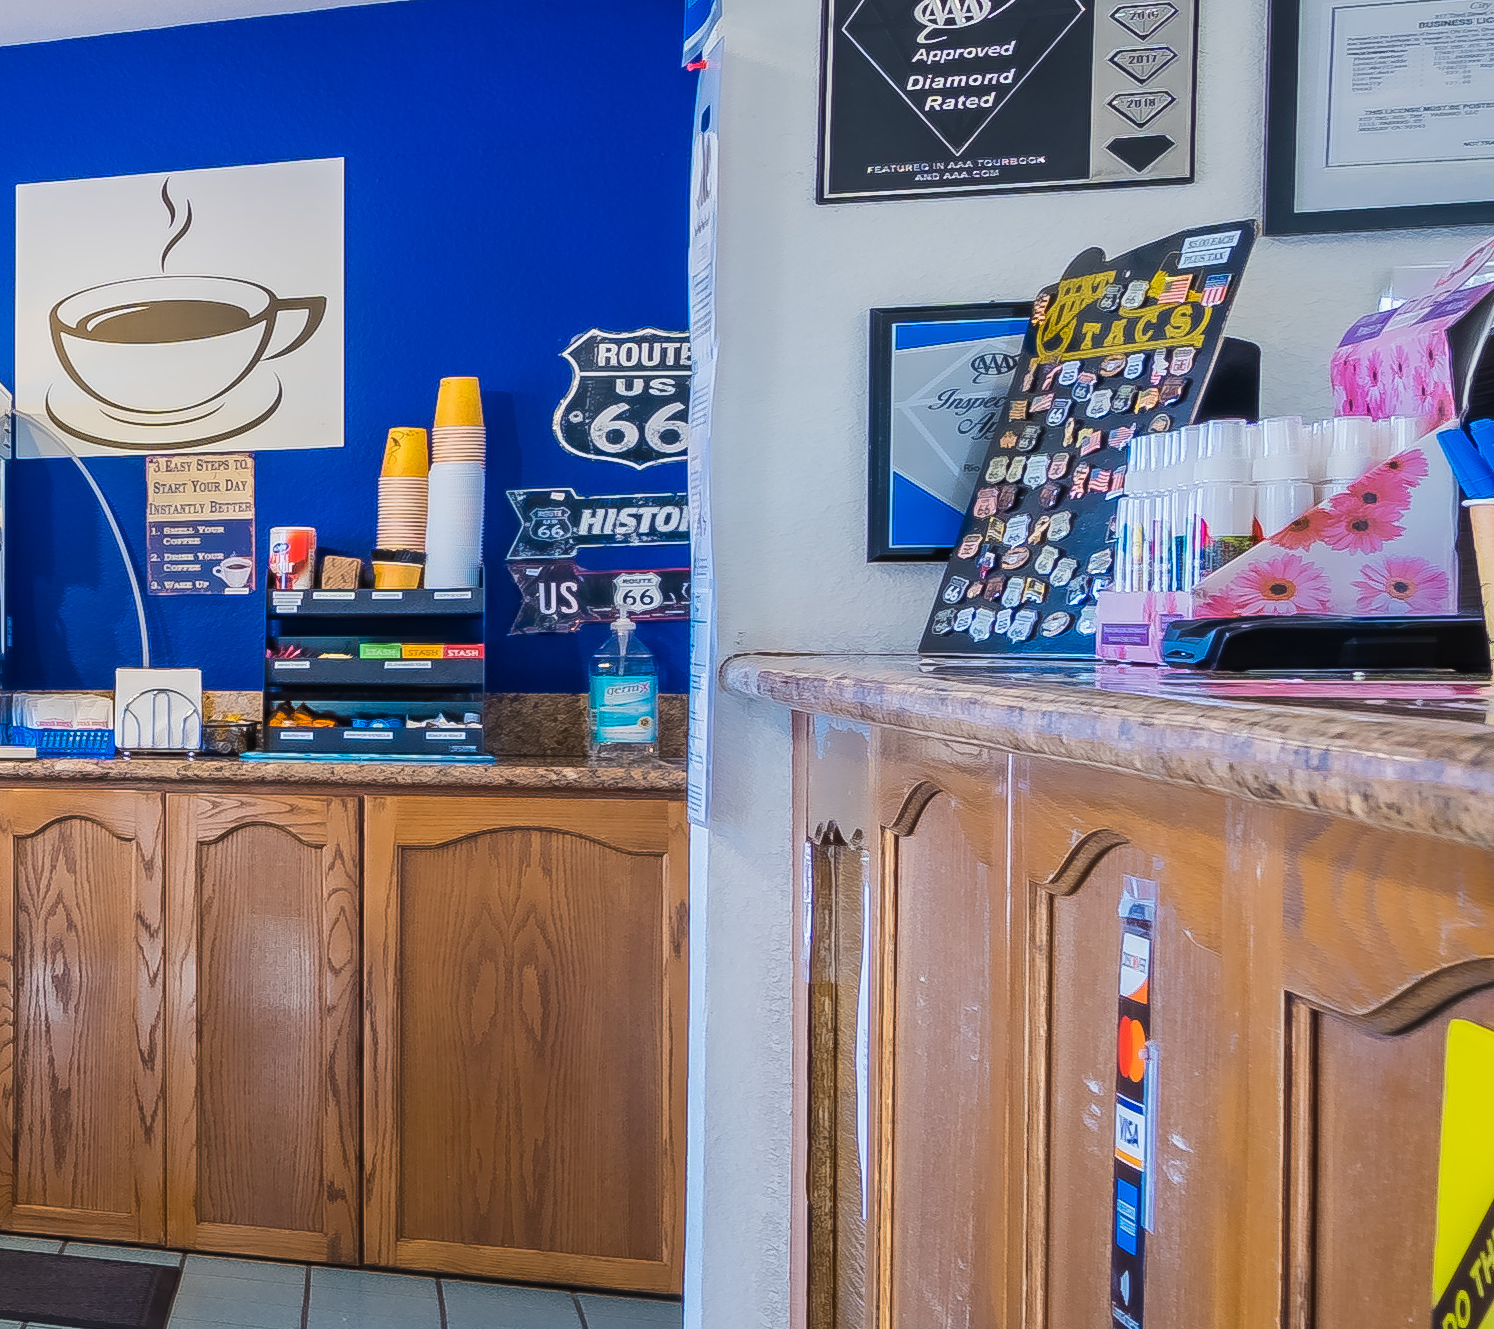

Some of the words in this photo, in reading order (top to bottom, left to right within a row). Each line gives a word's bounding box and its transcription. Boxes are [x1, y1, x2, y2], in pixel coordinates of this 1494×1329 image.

[1418, 18, 1473, 29] BUSINESS
[912, 40, 1016, 65] Approved
[1128, 53, 1158, 65] 2017
[906, 67, 1015, 92] Diamond
[923, 91, 996, 113] Rated
[1126, 98, 1156, 109] 2018
[867, 162, 930, 174] FEATURED
[933, 162, 945, 170] IN
[947, 160, 974, 169] AAA
[977, 155, 1046, 168] TOURBOOK
[1080, 305, 1194, 350] TACS
[598, 341, 691, 367] ROUTE
[975, 354, 1013, 374] AAA
[614, 377, 677, 396] US
[589, 401, 690, 454] 66
[537, 524, 565, 538] 66
[538, 581, 579, 615] US
[622, 588, 655, 607] 66
[407, 648, 440, 657] STASH
[447, 648, 480, 658] STASH
